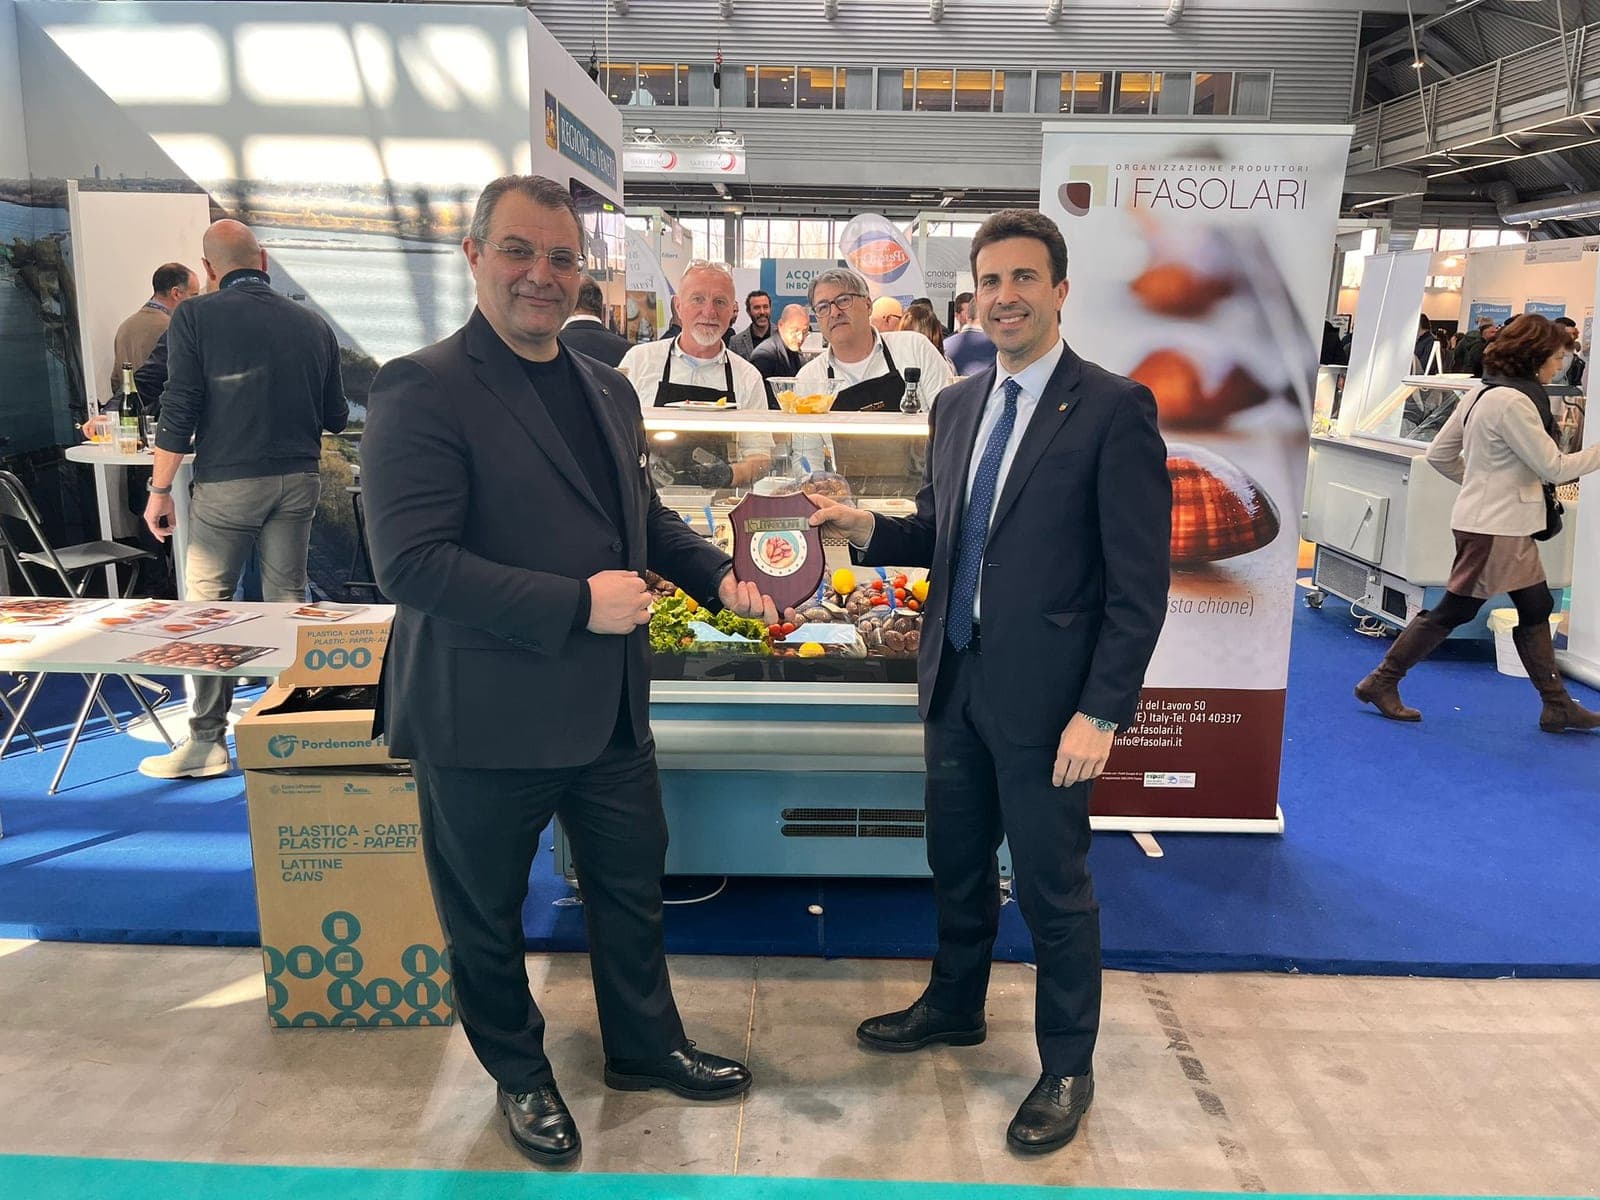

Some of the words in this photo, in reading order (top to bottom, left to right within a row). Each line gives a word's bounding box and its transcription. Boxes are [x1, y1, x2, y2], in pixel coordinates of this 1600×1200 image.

[561, 117, 590, 161] REGIONE
[598, 146, 616, 180] VENETO
[1115, 163, 1223, 172] ORGANIZZAZIONE
[1114, 177, 1119, 208] I
[1133, 177, 1307, 209] FASOLARI
[1197, 596, 1254, 617] chione)
[1146, 700, 1159, 710] del
[1162, 701, 1192, 711] Lavoro
[1194, 701, 1206, 711] 50
[1190, 713, 1206, 723] 041
[1208, 713, 1242, 724] 403317
[1124, 725, 1183, 735] w.fasolari.it
[302, 739, 371, 749] Pordenone
[1114, 735, 1183, 747] info@fasolari.it
[278, 825, 359, 837] PLASTICA
[375, 824, 422, 836] CART
[279, 837, 348, 849] PLASTIC
[364, 836, 417, 848] PAPER
[281, 859, 343, 870] LATTINE
[282, 871, 324, 882] CANS
